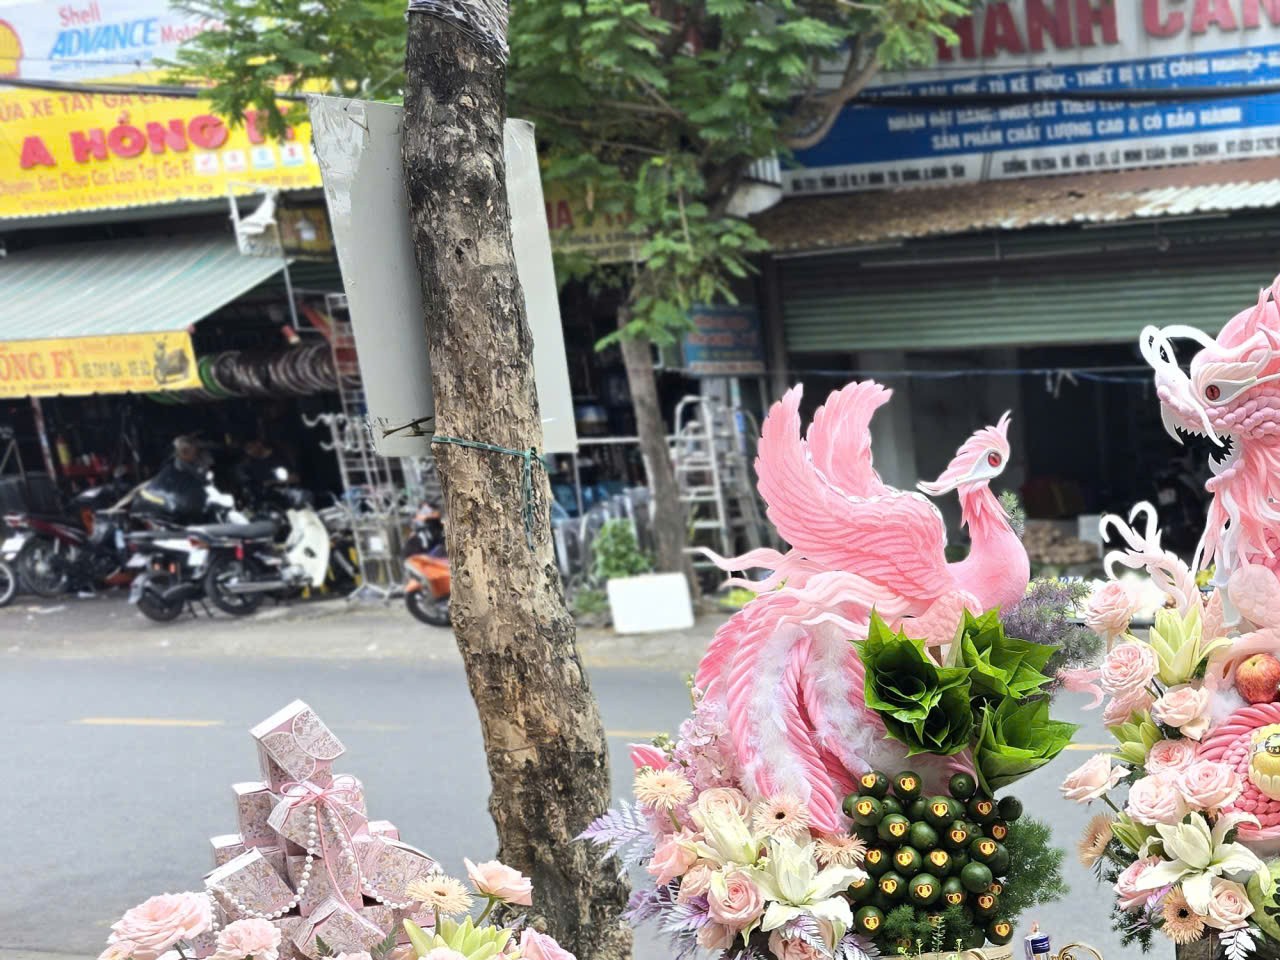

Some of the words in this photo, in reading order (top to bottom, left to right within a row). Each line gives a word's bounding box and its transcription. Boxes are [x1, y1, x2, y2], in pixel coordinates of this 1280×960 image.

[58, 2, 101, 27] Shell
[49, 17, 158, 59] ADVANCE
[930, 0, 1118, 62] HANH
[1135, 64, 1146, 80] Y
[31, 97, 55, 118] XE
[1096, 117, 1125, 135] CAO
[1142, 111, 1163, 130] CÓ
[1166, 107, 1196, 129] BẢO
[20, 135, 57, 169] A
